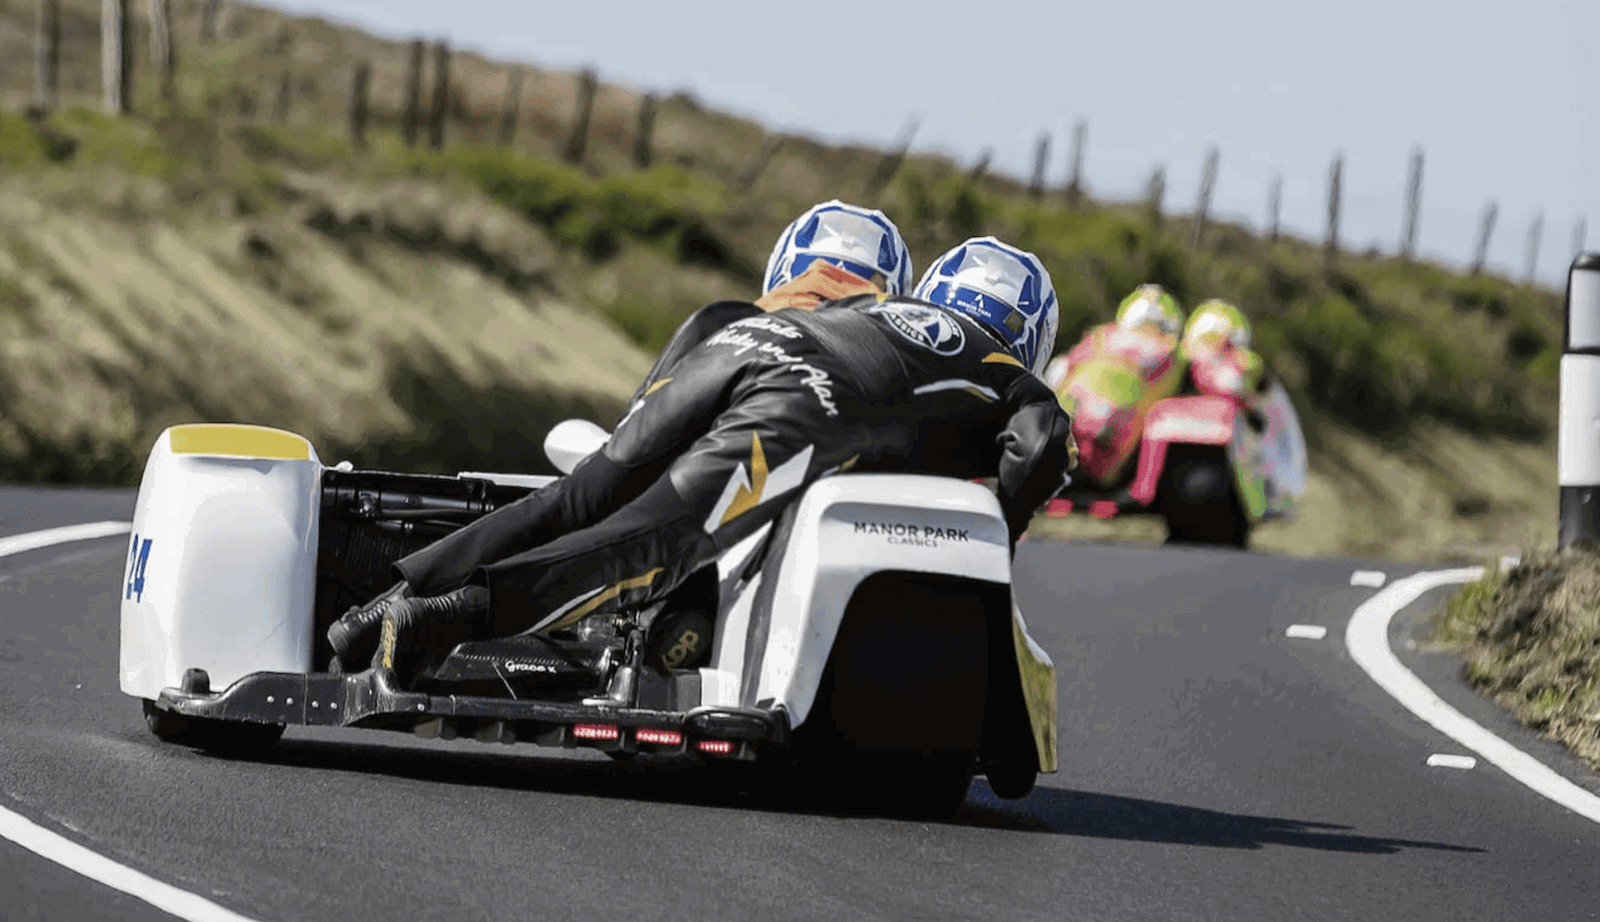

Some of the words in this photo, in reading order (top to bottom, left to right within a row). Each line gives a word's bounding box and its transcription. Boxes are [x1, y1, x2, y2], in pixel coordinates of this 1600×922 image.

[790, 363, 840, 417] Alan
[854, 521, 919, 537] MANOR
[924, 525, 970, 542] PARK
[887, 536, 938, 548] CLASSICS
[126, 532, 153, 603] 24
